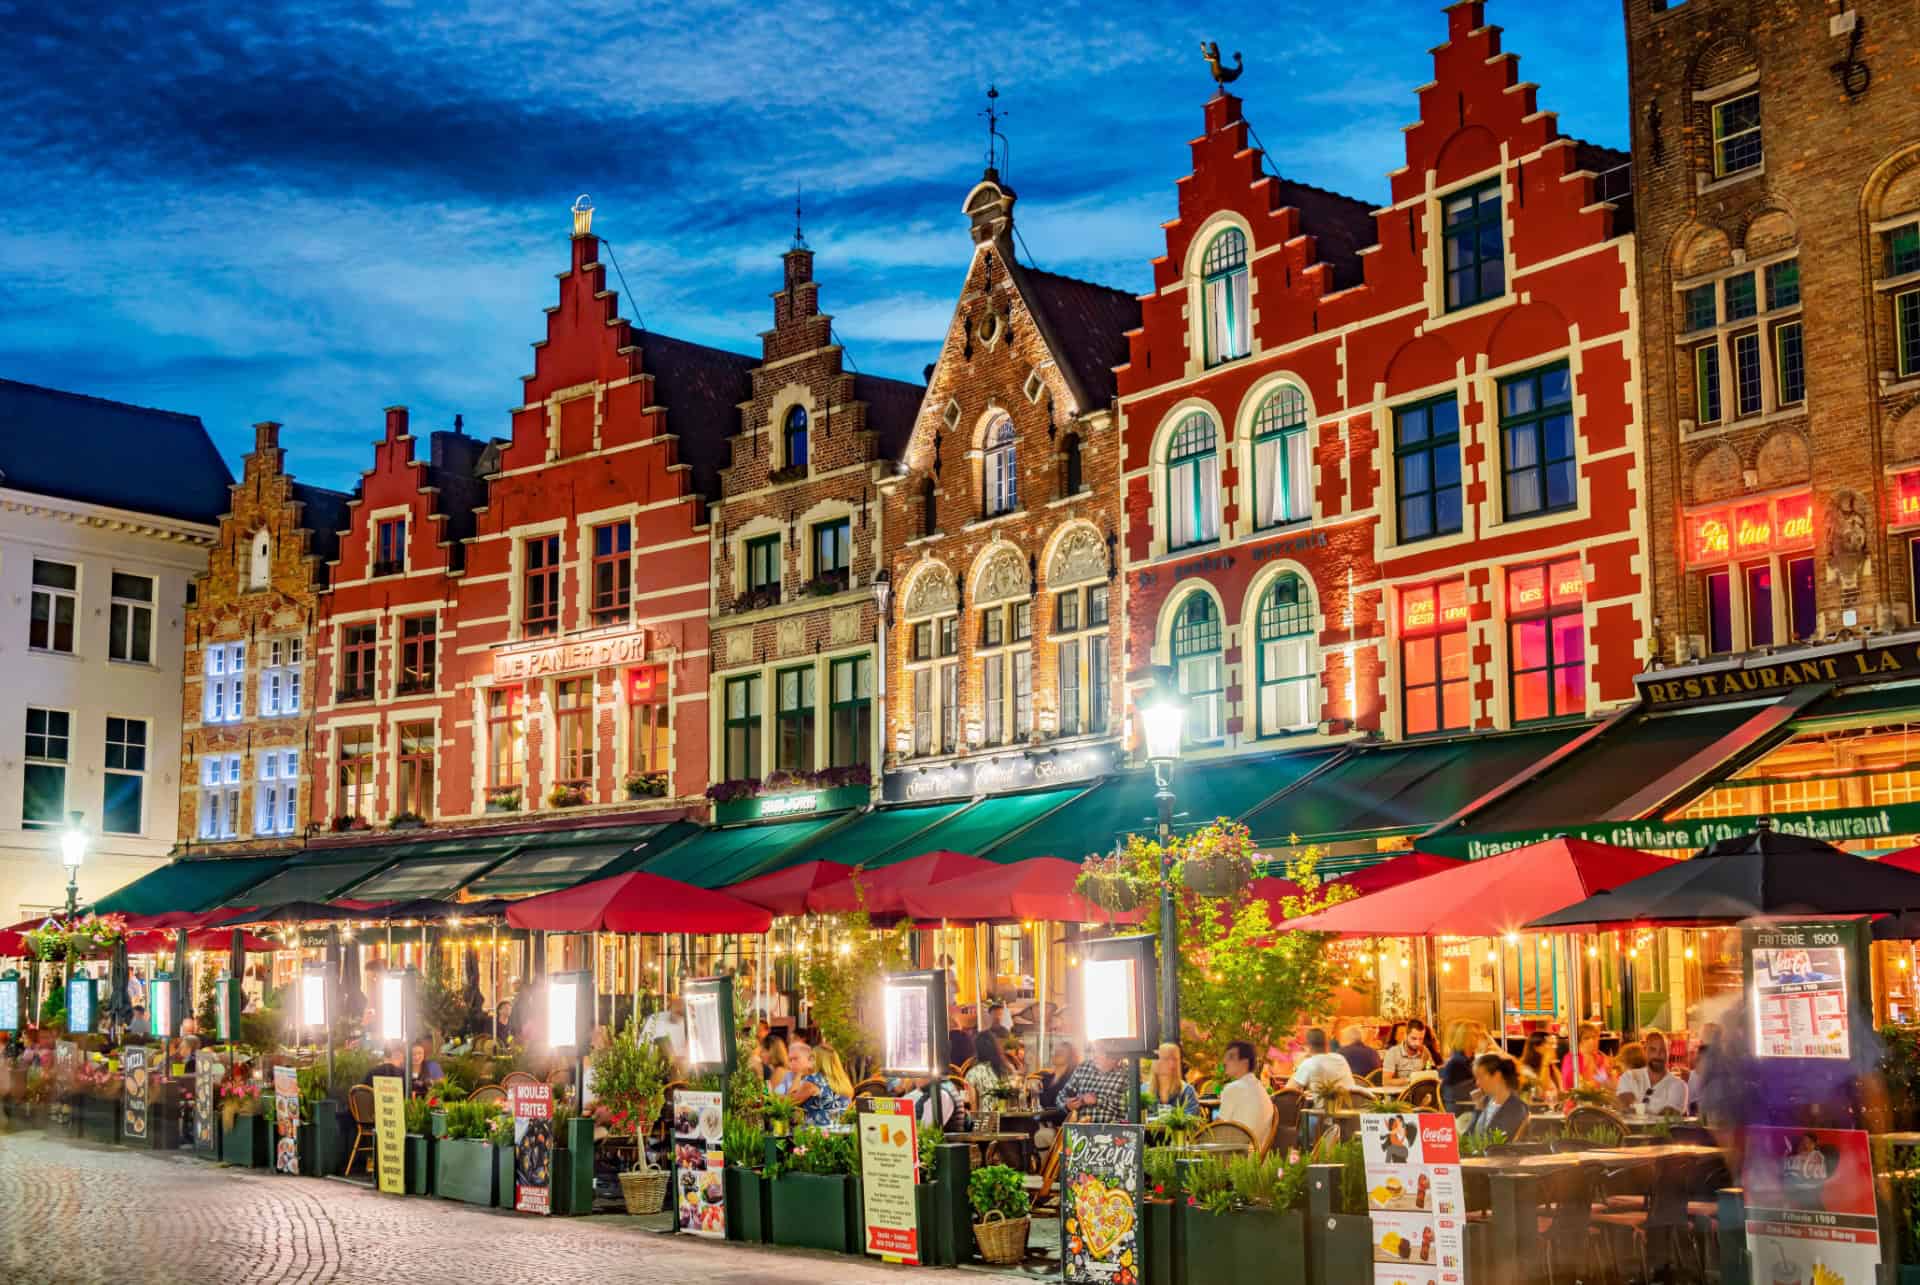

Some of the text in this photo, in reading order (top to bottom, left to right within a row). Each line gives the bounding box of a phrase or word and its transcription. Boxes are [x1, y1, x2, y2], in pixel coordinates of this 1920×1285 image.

[503, 637, 643, 679] LE PANIER D'OR
[1648, 657, 1839, 703] RESTAURANT
[1855, 650, 1902, 673] LA
[1612, 827, 1689, 848] Civiere
[1768, 811, 1892, 839] estaurant
[1757, 933, 1839, 945] FRITERIE 1900
[518, 1085, 549, 1099] MOULES
[520, 1103, 548, 1117] FRITES
[1068, 1134, 1136, 1171] Pizzeria
